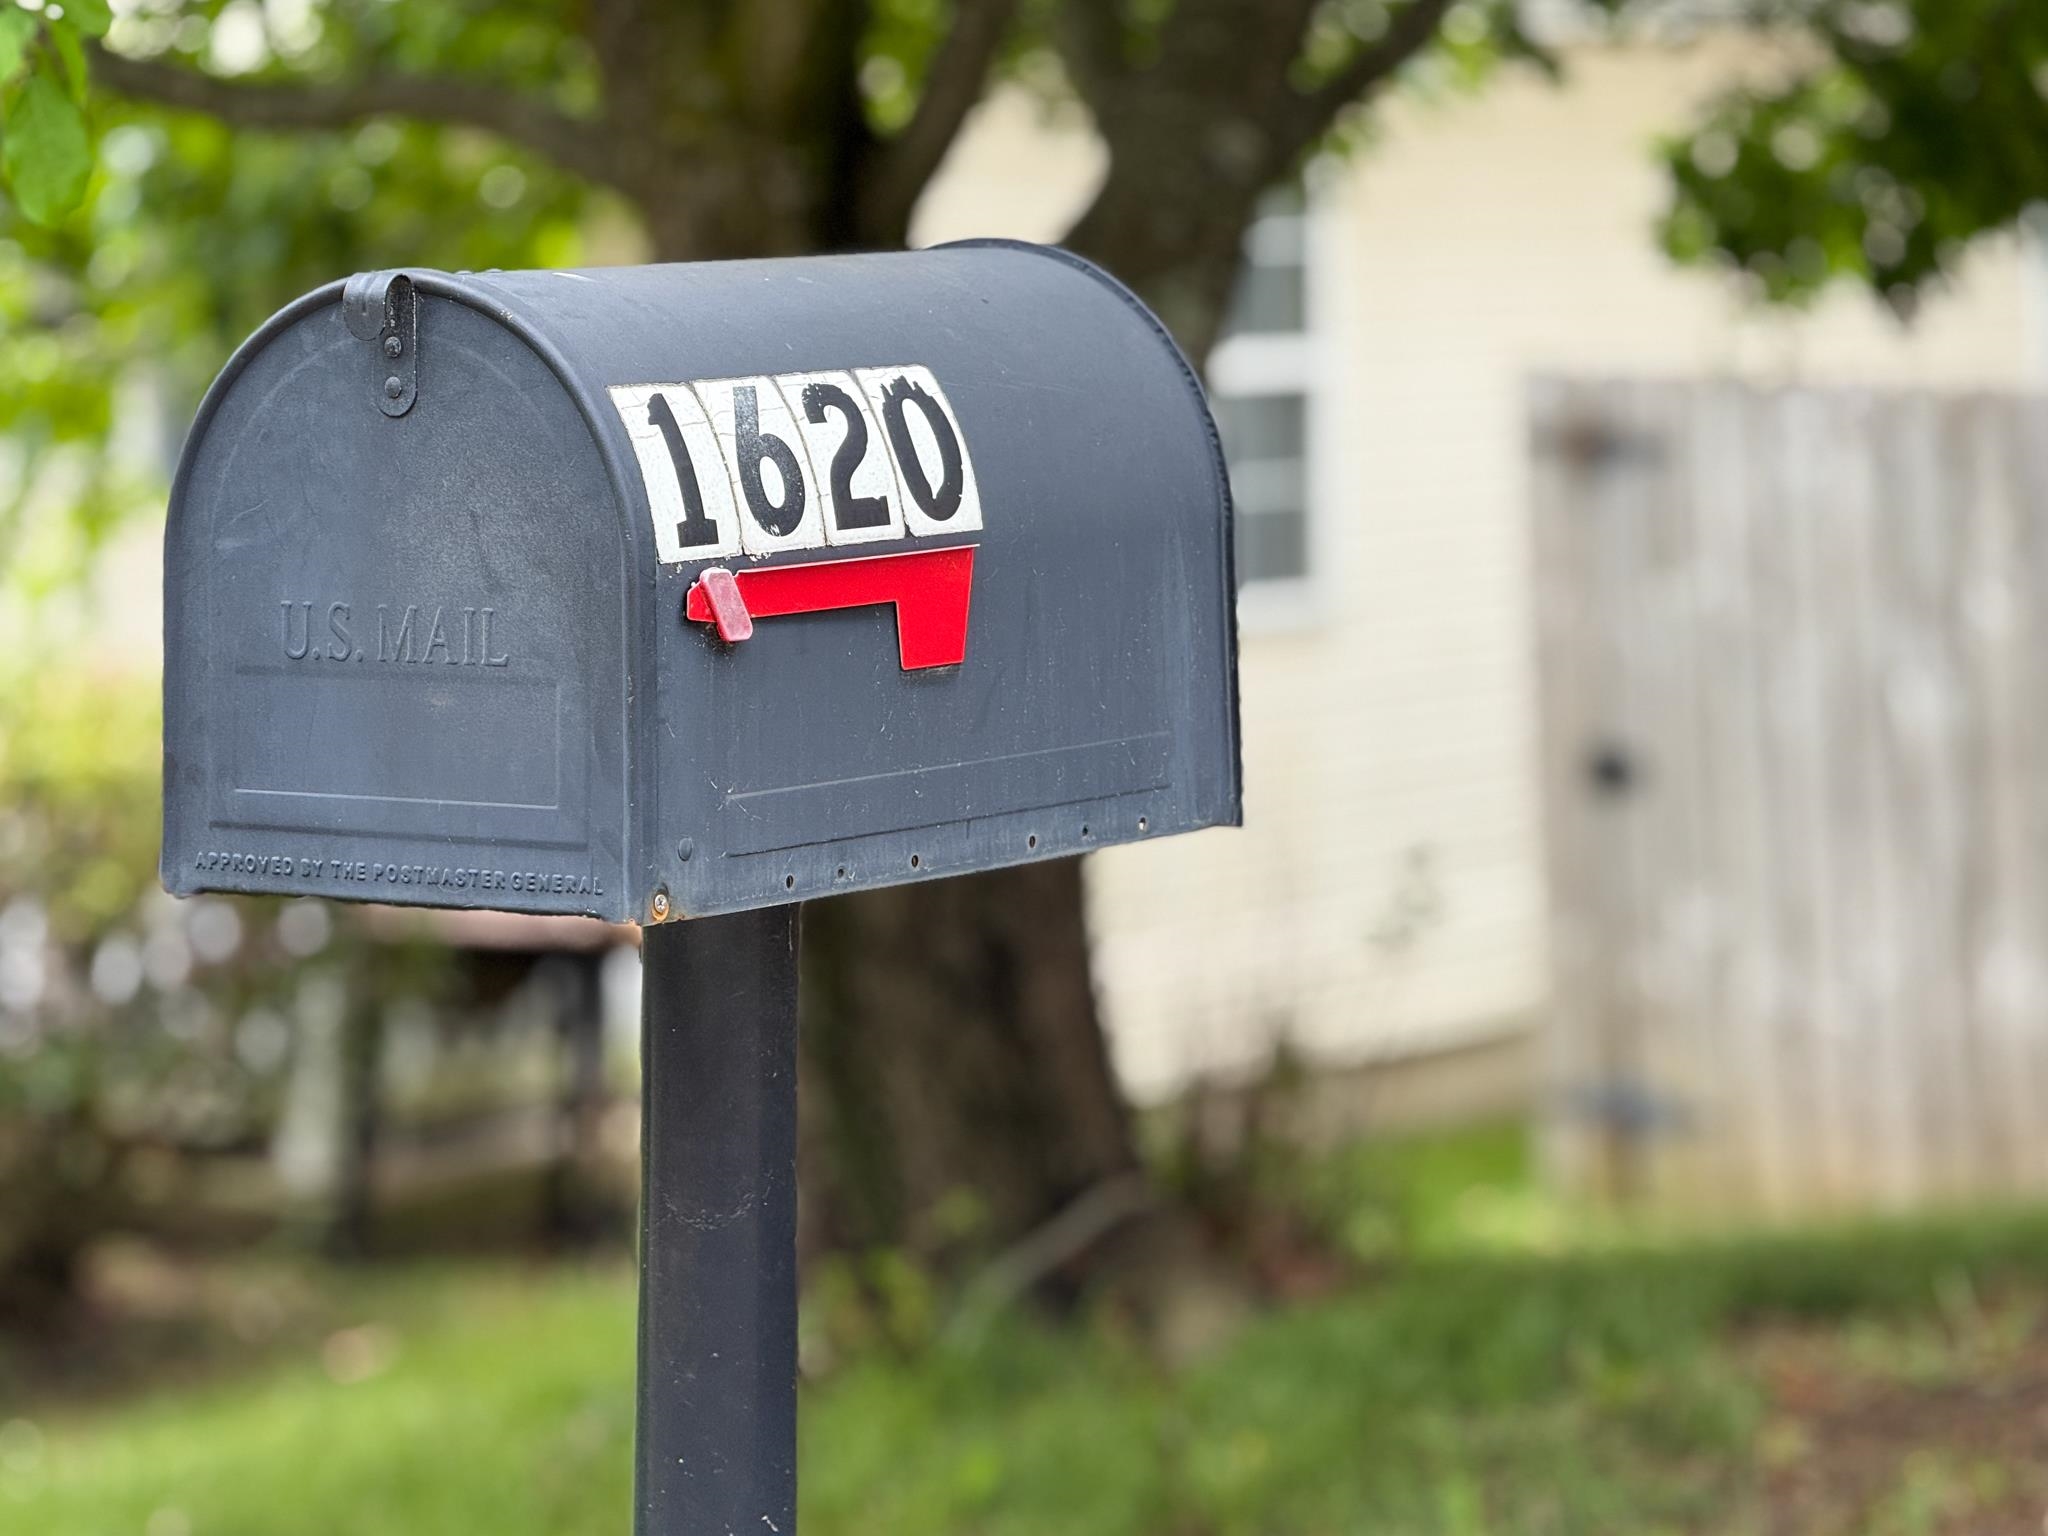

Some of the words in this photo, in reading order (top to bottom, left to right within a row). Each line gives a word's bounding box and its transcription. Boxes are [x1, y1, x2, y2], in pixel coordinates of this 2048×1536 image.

[647, 375, 964, 549] 1620
[280, 600, 363, 663] U.S.
[376, 604, 510, 668] MAIL
[195, 851, 294, 876] APPROVED
[300, 857, 323, 879] BY
[330, 859, 366, 882] THE
[373, 862, 505, 891] POSTMASTER
[510, 871, 604, 896] GENERAL
